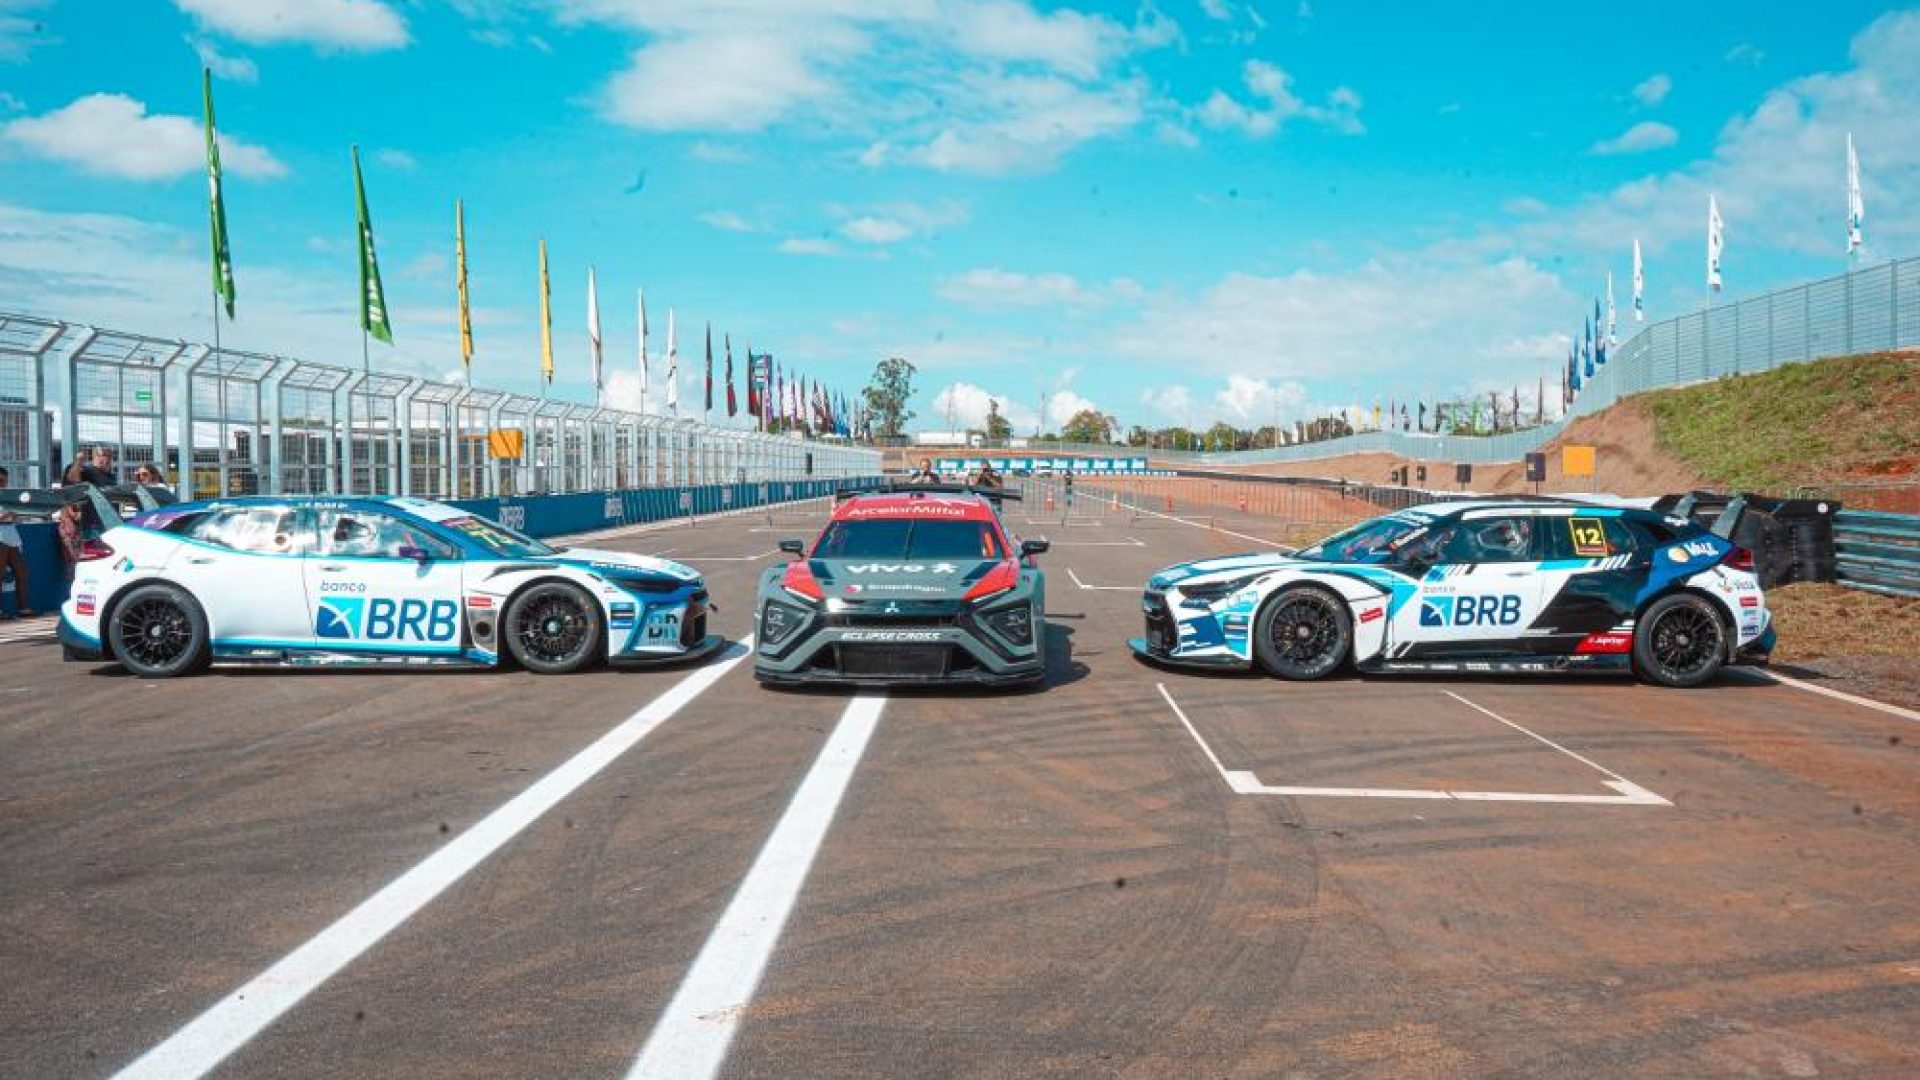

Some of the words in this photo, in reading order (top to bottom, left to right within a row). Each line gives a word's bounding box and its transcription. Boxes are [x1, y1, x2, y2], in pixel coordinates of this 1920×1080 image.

[848, 505, 964, 517] ArcelorMittal
[1575, 528, 1602, 545] 12
[846, 563, 925, 573] vivo
[320, 579, 367, 592] banco
[1455, 594, 1522, 626] BRB
[366, 598, 458, 642] BRB
[841, 632, 895, 641] ECLIPSE
[896, 632, 941, 641] CROSS
